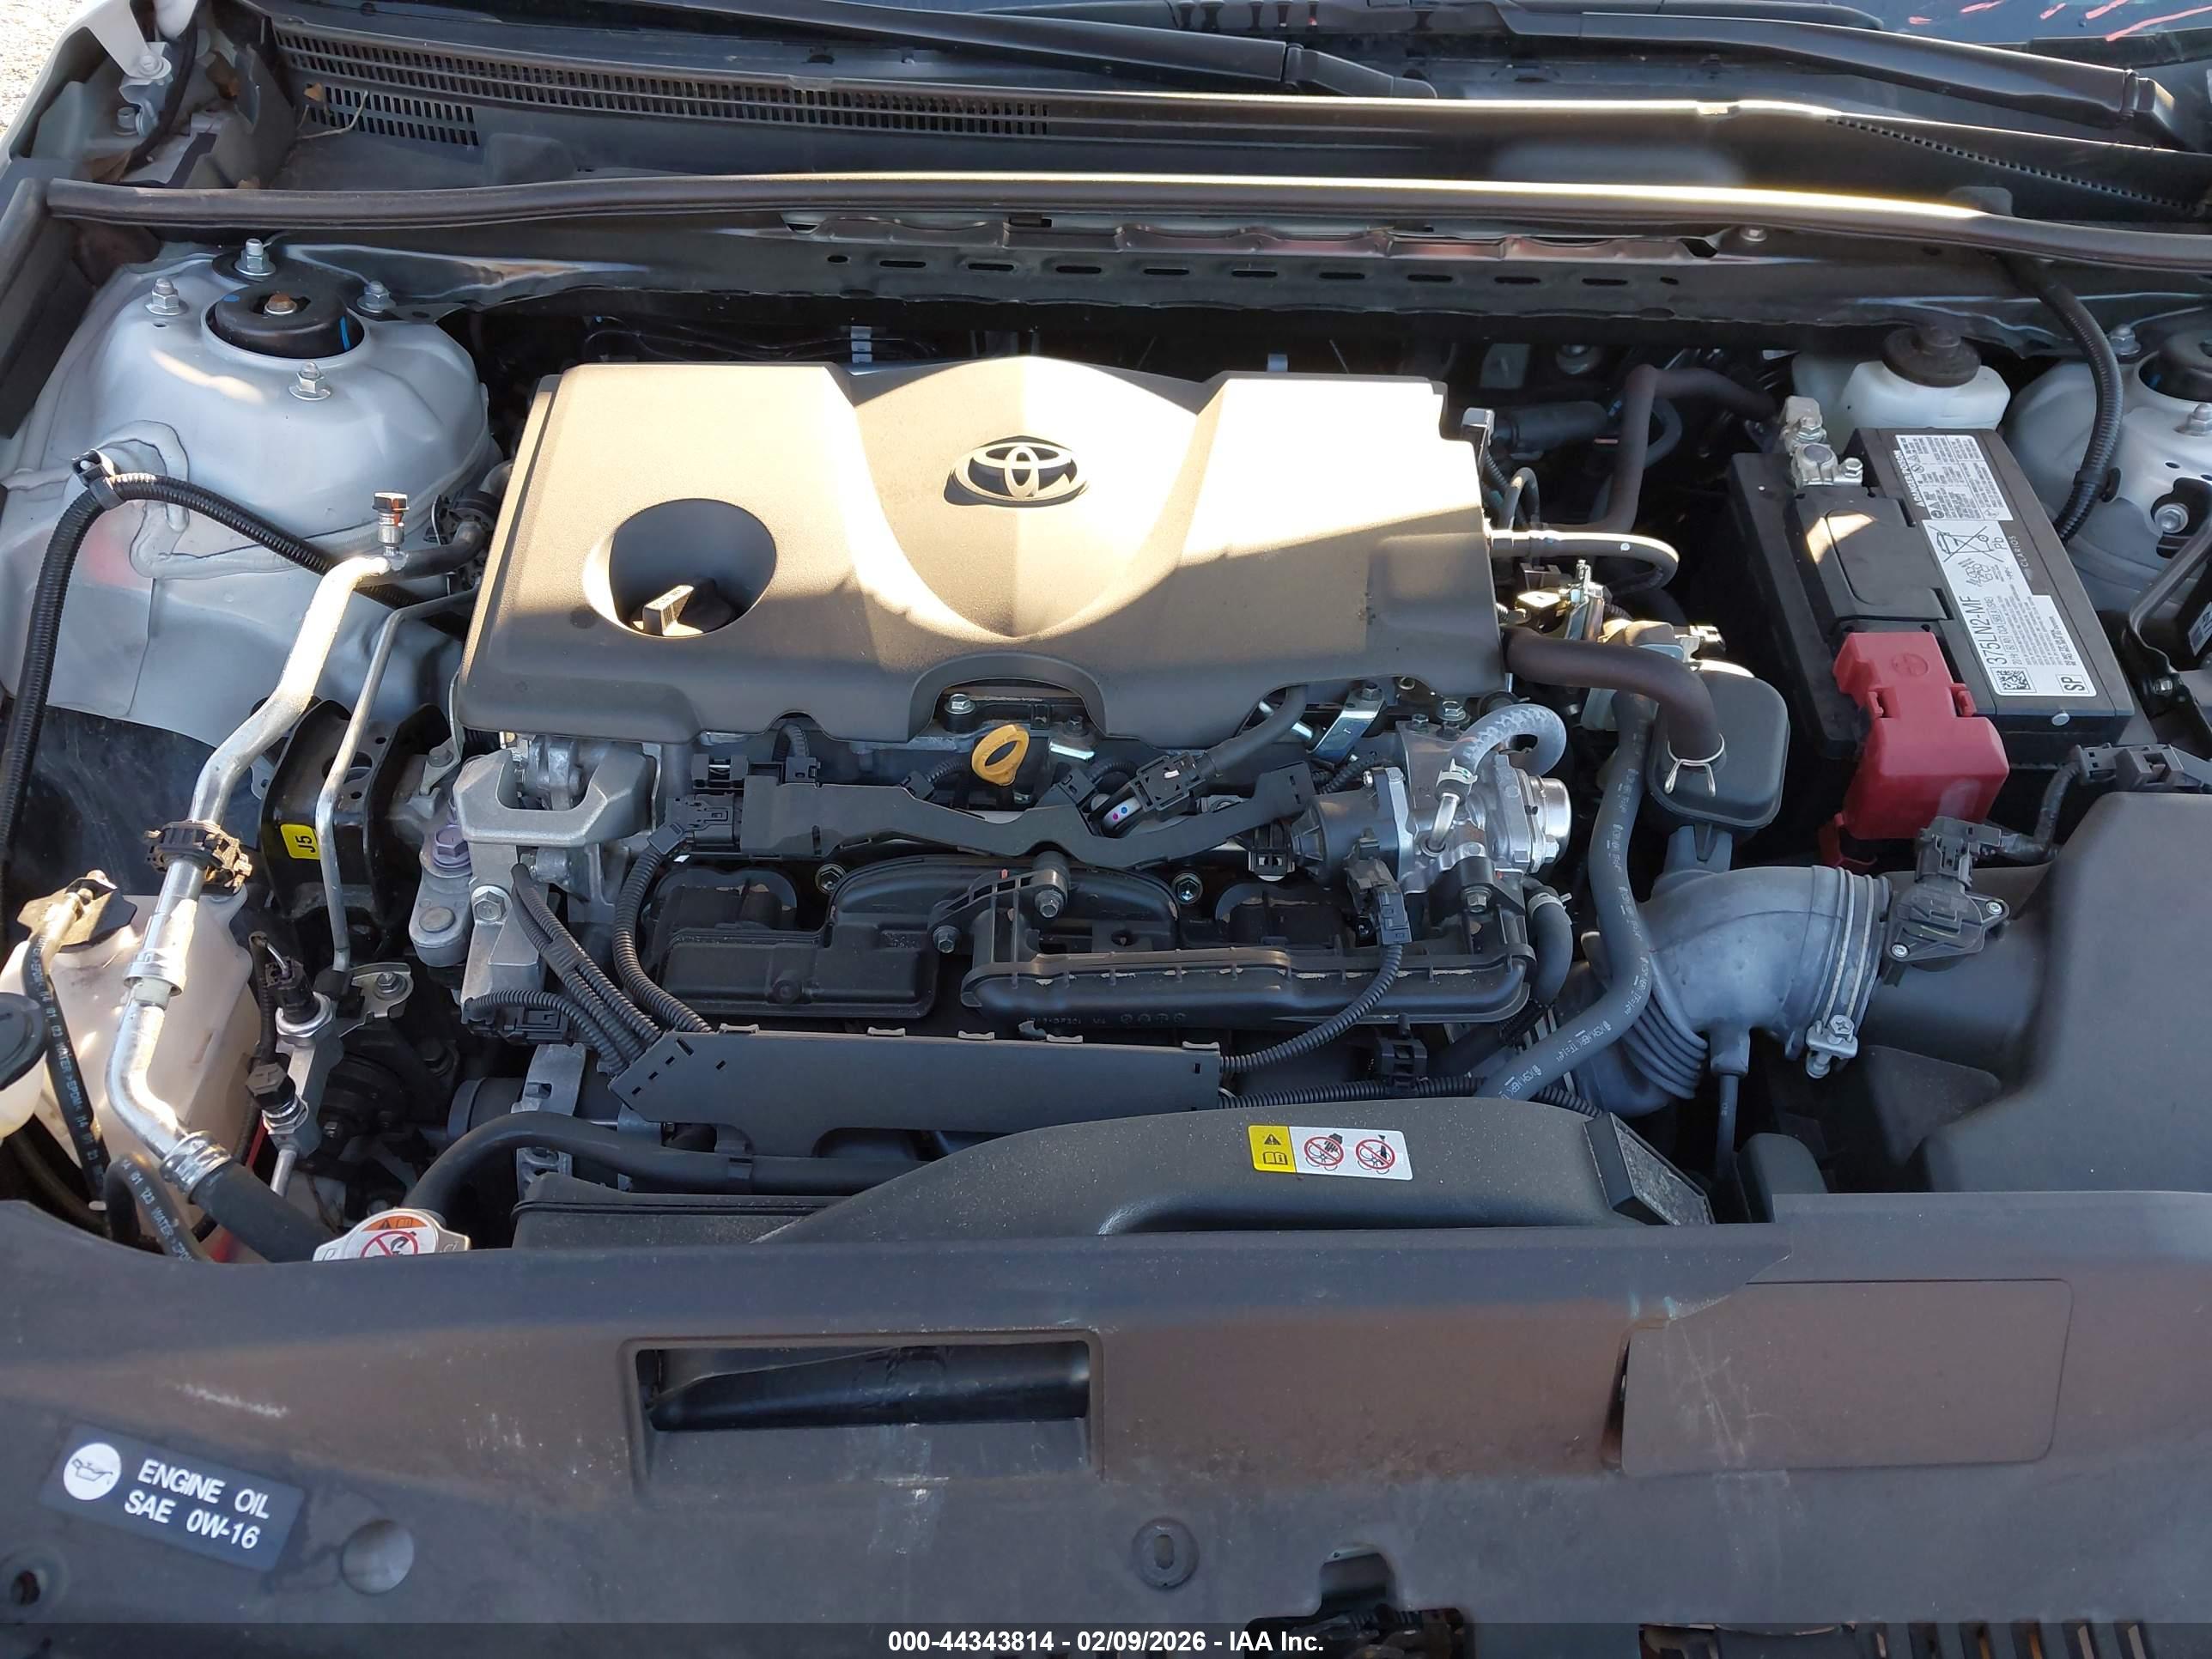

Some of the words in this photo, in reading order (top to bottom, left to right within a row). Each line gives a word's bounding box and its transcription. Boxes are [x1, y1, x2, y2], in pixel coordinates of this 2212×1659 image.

[1991, 537, 2007, 550] Pb
[2008, 535, 2028, 568] CLARIOS
[1959, 596, 2008, 665] 375LN2-MF
[2060, 676, 2086, 692] SP
[295, 836, 316, 853] J5
[56, 1042, 72, 1073] WATER
[149, 1207, 175, 1239] WATER
[137, 1458, 226, 1504] ENGINE
[234, 1488, 270, 1520] OIL
[125, 1489, 177, 1524] SAE
[186, 1509, 261, 1550] 0W-16
